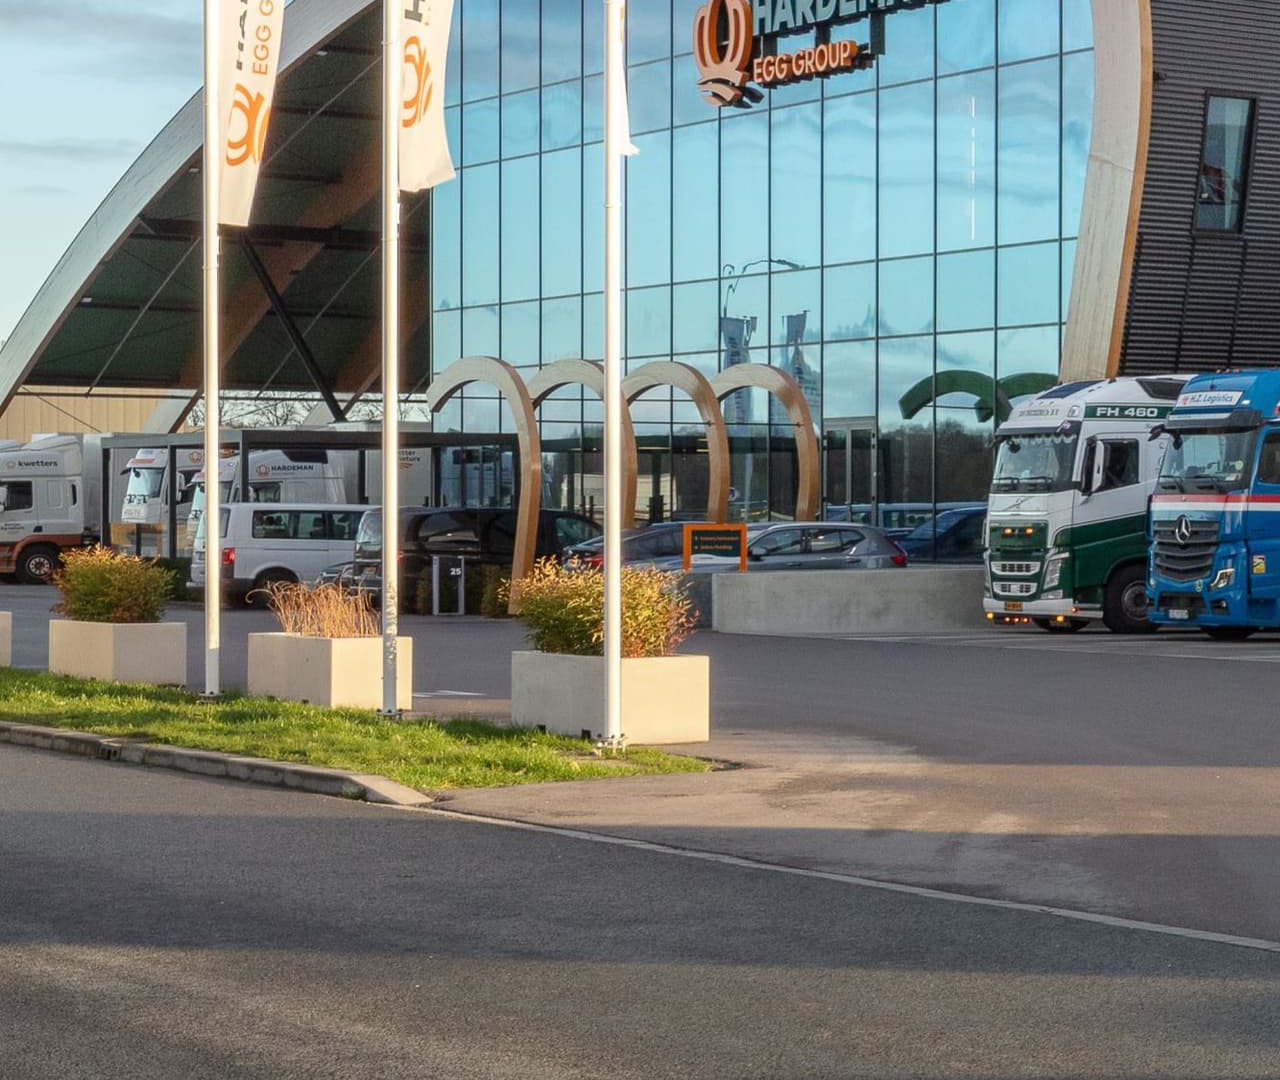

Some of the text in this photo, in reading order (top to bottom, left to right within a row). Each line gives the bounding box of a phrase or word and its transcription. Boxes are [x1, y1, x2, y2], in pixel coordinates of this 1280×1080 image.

[252, 22, 273, 76] EGG
[752, 40, 852, 83] EGG GROUP
[1095, 407, 1158, 417] FH 460
[271, 463, 315, 472] HARDEMAN
[449, 567, 462, 576] 25
